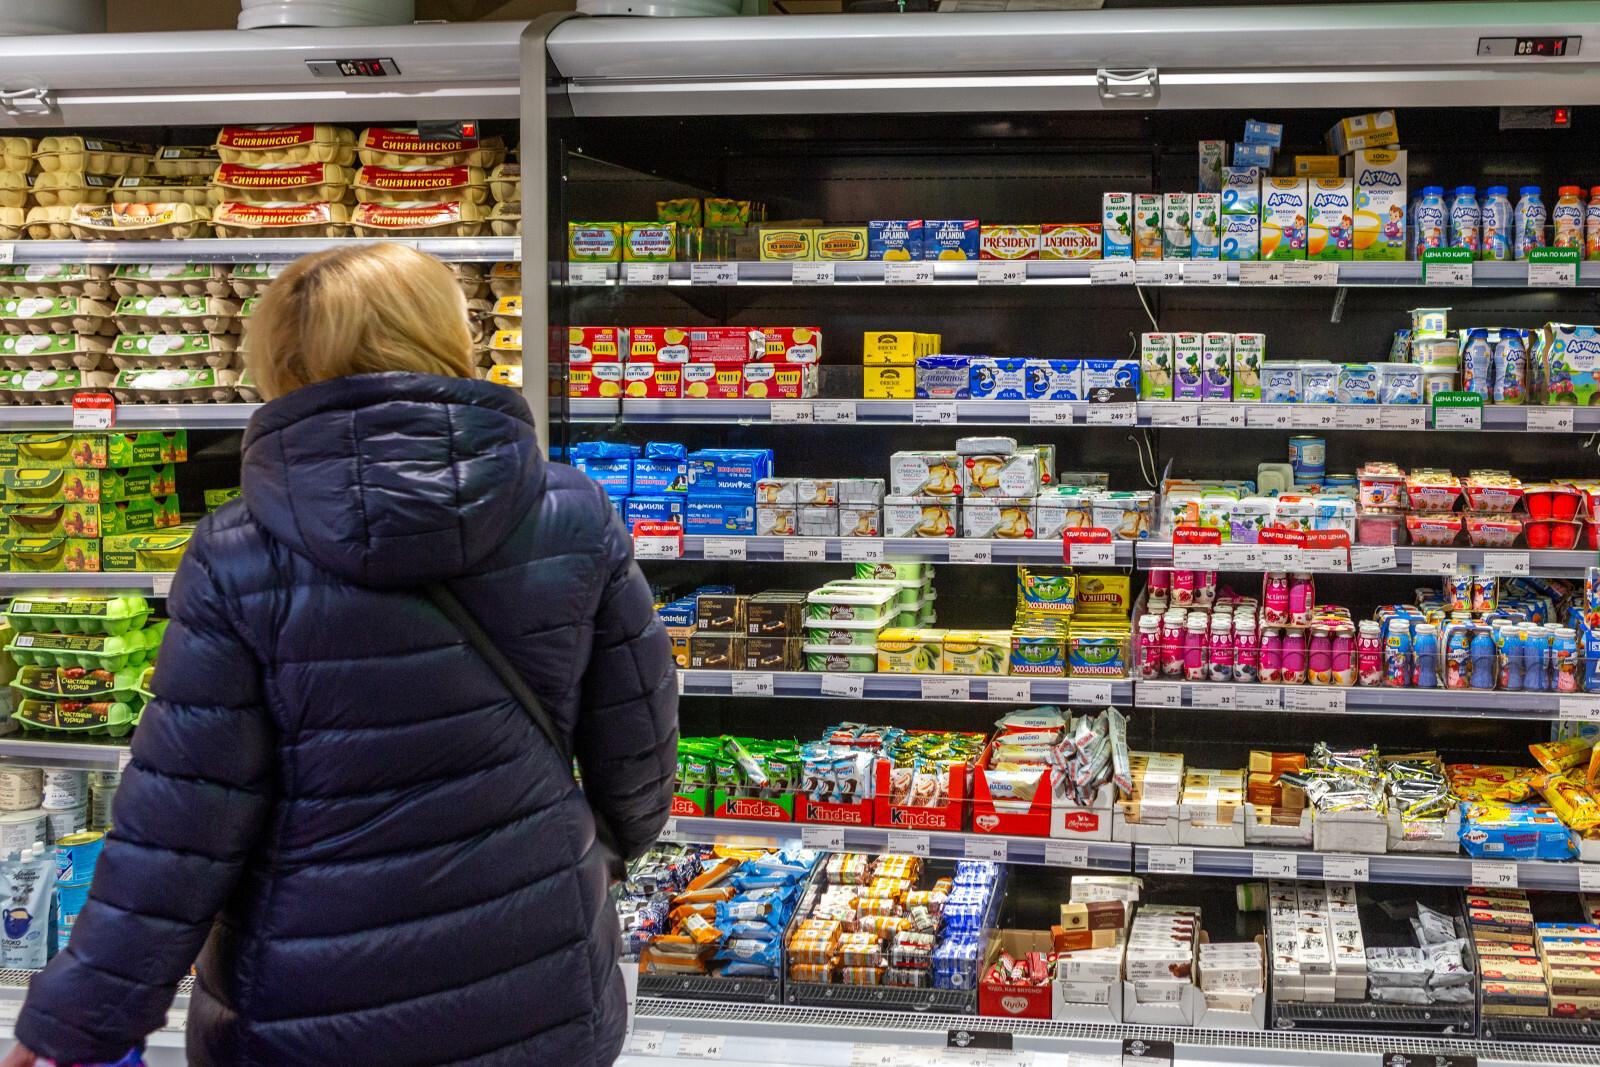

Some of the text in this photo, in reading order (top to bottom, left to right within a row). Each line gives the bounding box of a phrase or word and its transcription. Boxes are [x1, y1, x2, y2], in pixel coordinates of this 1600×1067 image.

[233, 134, 299, 146] СИНЯВИНСКОЕ
[1369, 131, 1393, 140] МОЛОКО
[382, 140, 462, 151] СИНЯВИНСКОЕ
[232, 175, 307, 185] СИНЯВИНСКОЕ
[376, 178, 452, 187] СИНЯВИНСКОЕ
[1360, 170, 1401, 187] АГУША
[1224, 190, 1239, 210] 2
[1268, 193, 1302, 207] АГУША
[1314, 193, 1349, 207] АГУША
[122, 214, 158, 224] Экстра
[640, 230, 664, 238] Масло
[880, 232, 910, 240] LAPLANDIA
[936, 232, 966, 240] LAPLANDIA
[984, 236, 1037, 248] PRÉSIDENT
[1045, 236, 1098, 248] PRÉSIDENT
[1224, 238, 1239, 258] 2
[1028, 602, 1073, 611] ХОЗЯЮШКА
[1014, 665, 1063, 674] ХОЗЯЮШКА
[1073, 666, 1122, 674] ХОЗЯЮШКА
[62, 678, 97, 686] Счастливая
[58, 711, 92, 719] Счастливая
[64, 716, 85, 724] курица
[726, 800, 777, 816] Kinder
[807, 804, 858, 821] Kinder
[891, 810, 943, 825] Kinder
[1004, 1000, 1027, 1011] Чудо
